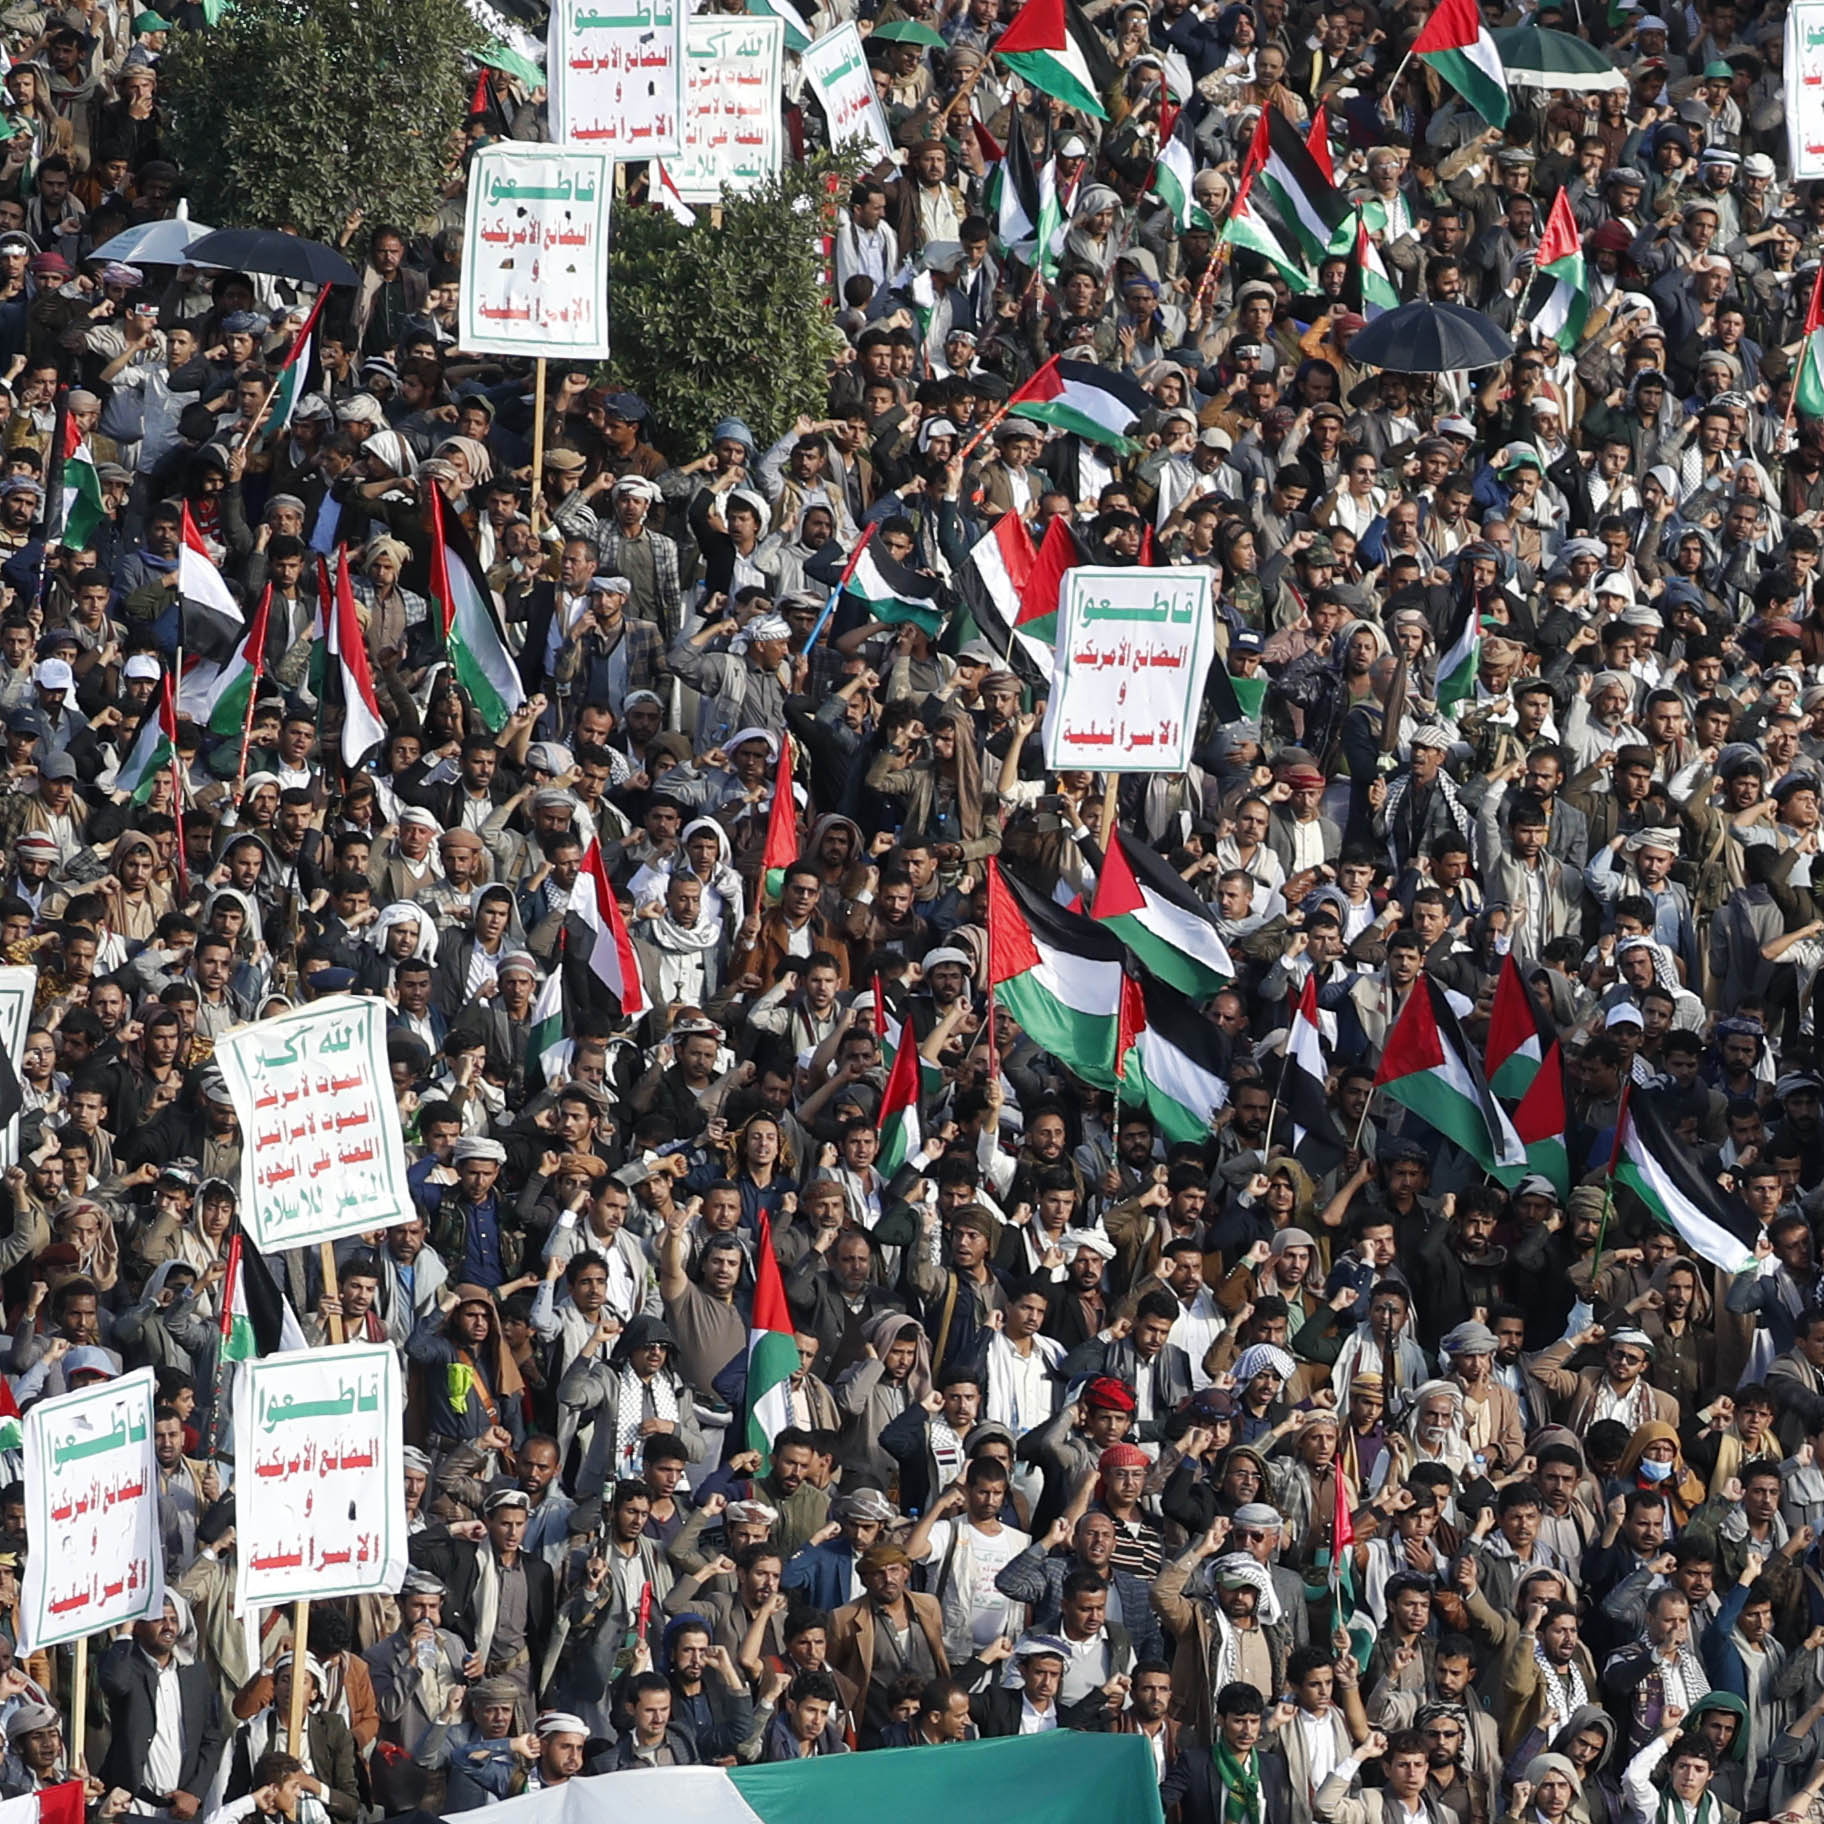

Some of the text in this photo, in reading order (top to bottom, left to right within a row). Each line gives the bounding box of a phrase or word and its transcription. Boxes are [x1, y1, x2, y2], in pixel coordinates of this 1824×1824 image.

[318, 1019, 370, 1054] الله
[315, 1064, 368, 1097] الموت
[320, 1101, 376, 1135] الموت
